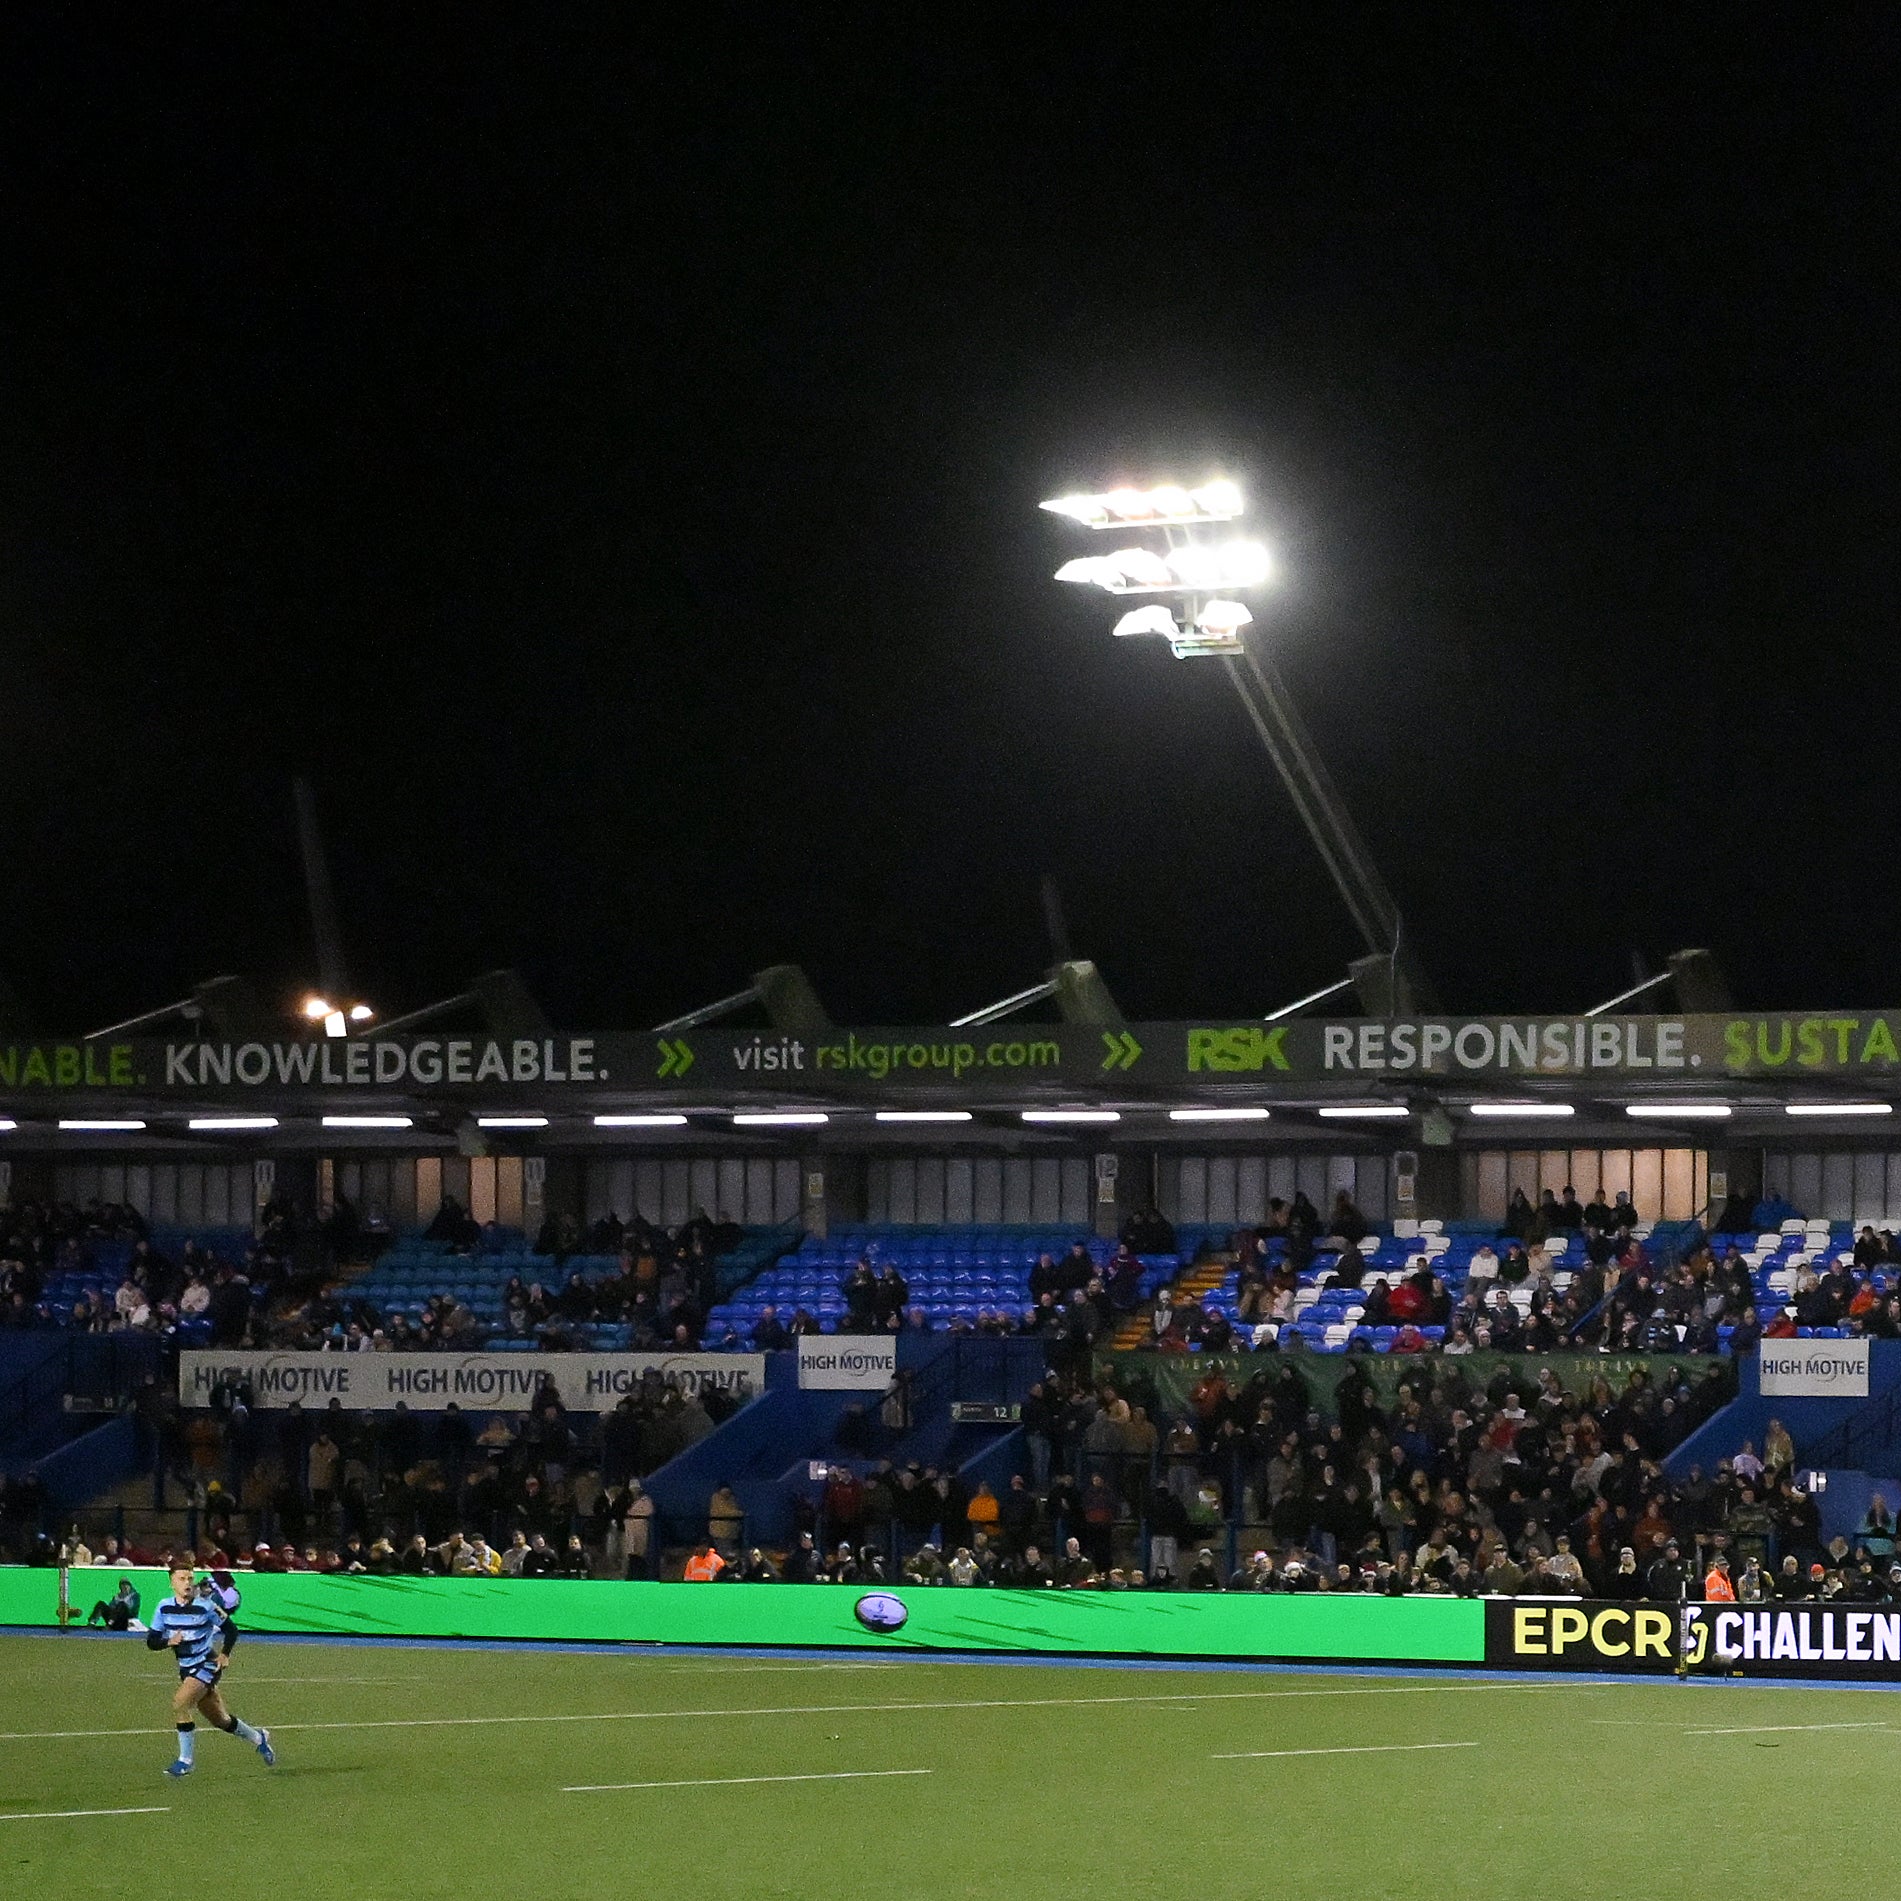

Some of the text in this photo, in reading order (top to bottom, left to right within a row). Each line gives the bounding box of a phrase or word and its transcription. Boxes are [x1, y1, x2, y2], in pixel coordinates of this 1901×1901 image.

[165, 1040, 609, 1085] KNOWLEDGEABLE.
[734, 1037, 804, 1071] visit
[816, 1033, 1060, 1079] rskgroup.com
[1187, 1026, 1293, 1073] RSK
[1323, 1022, 1701, 1071] RESPONSIBLE.
[801, 1354, 894, 1371] HIGH MOTIVE
[1762, 1359, 1866, 1376] HIGH MOTIVE
[260, 1367, 349, 1392] MOTIVE
[387, 1368, 448, 1393] HIGH
[993, 1406, 1008, 1419] 12
[1513, 1607, 1672, 1659] EPCR
